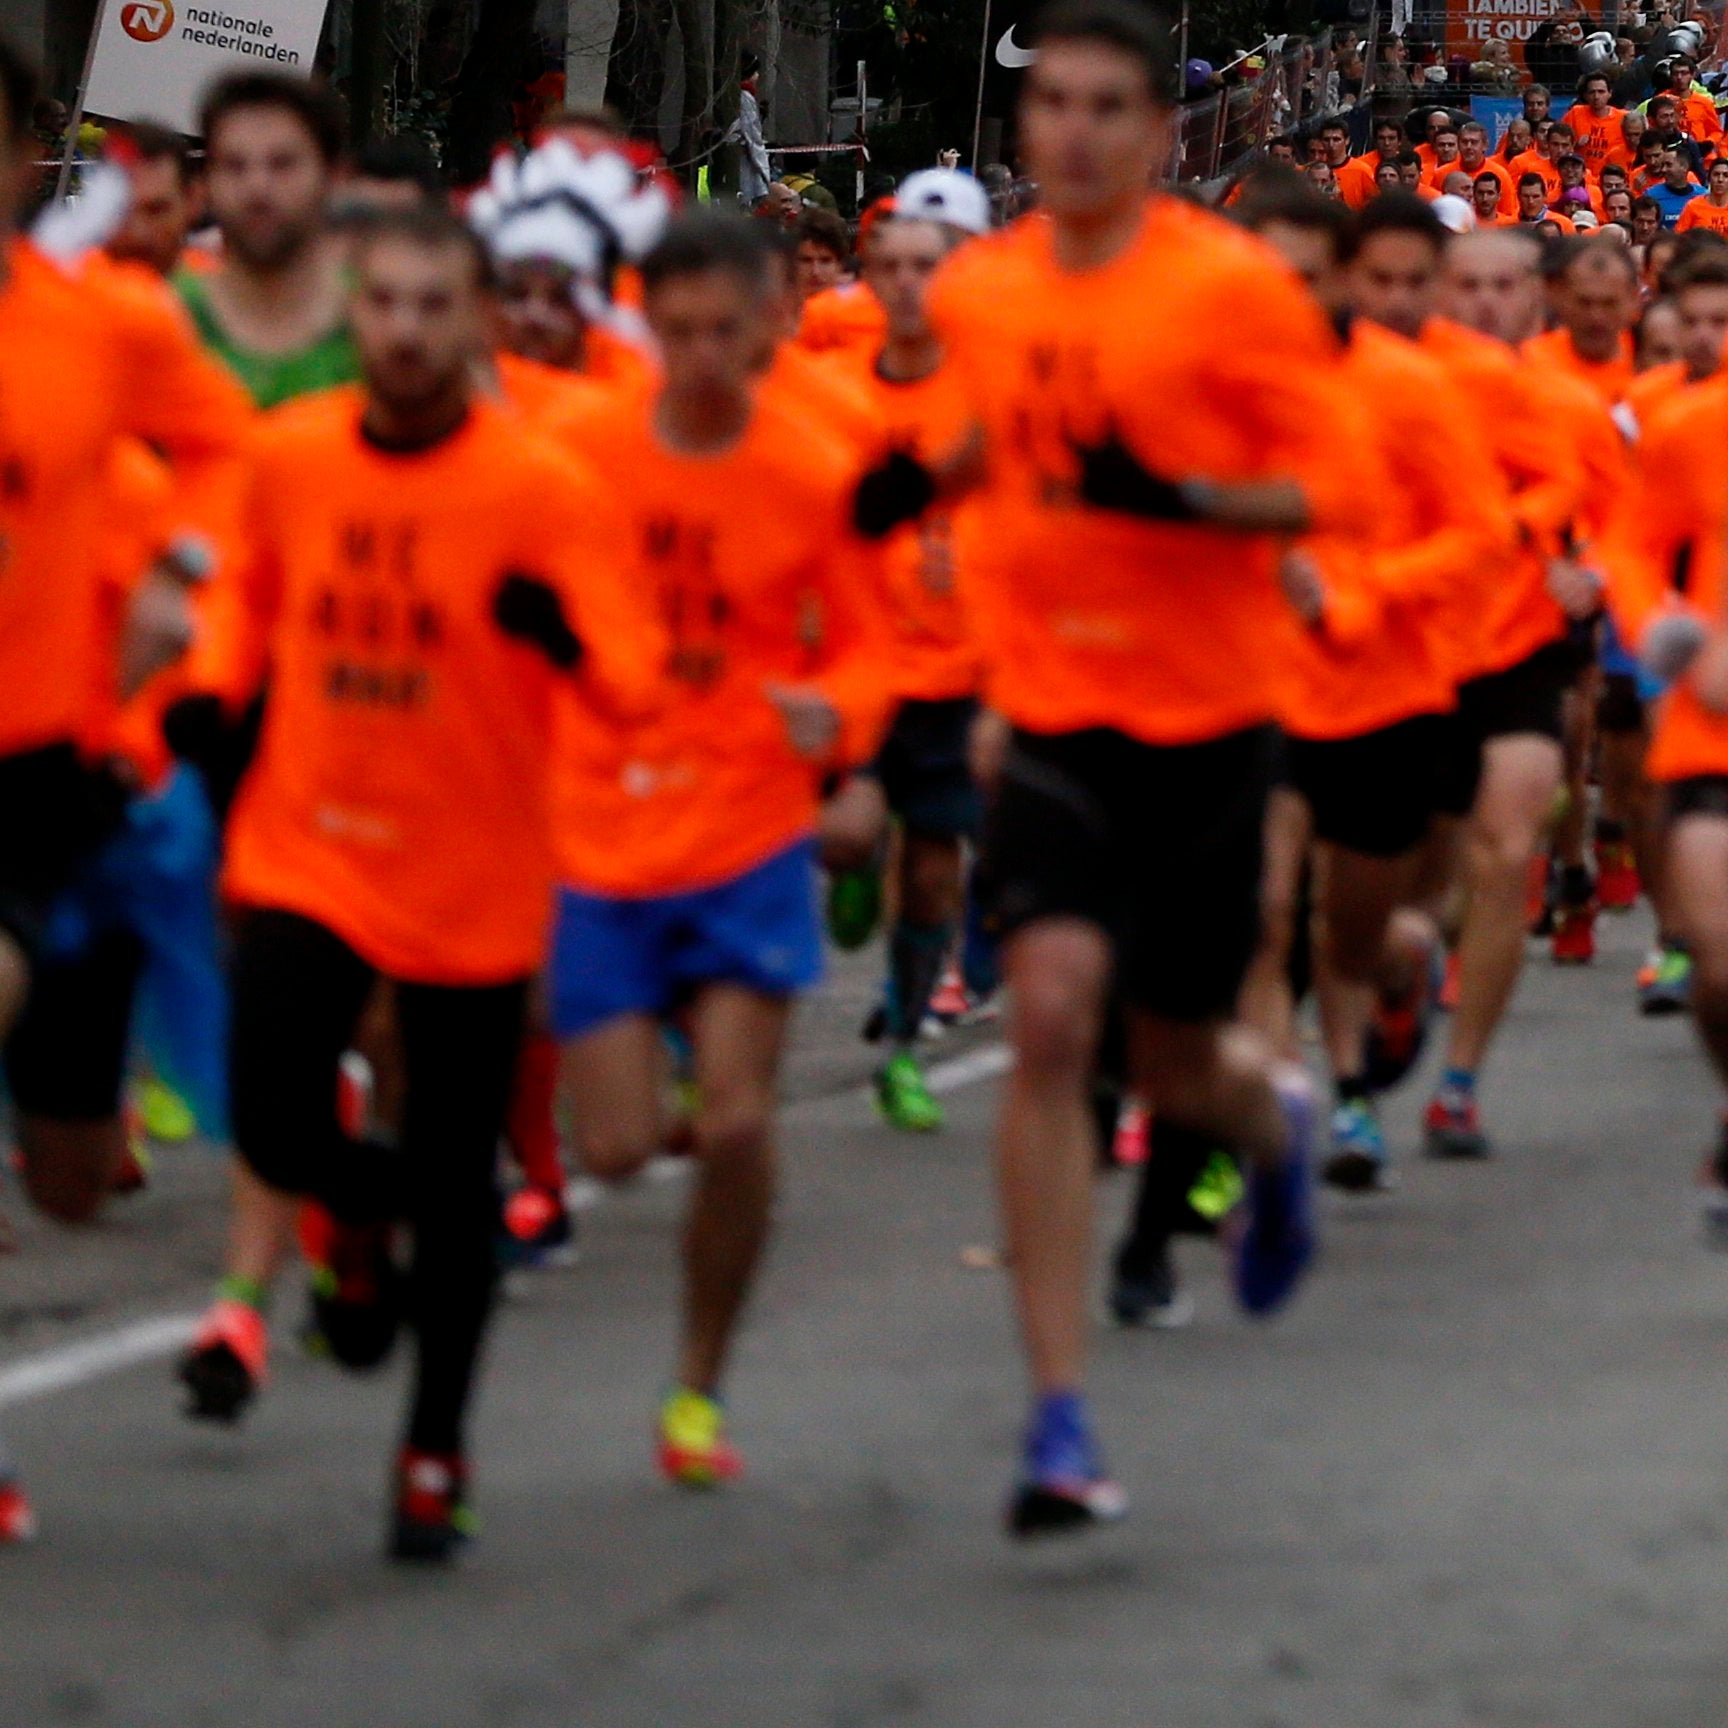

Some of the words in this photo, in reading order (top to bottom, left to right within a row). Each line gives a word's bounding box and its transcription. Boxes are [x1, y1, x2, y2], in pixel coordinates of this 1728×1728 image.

[187, 7, 273, 38] nationale
[1464, 20, 1490, 40] TE
[182, 27, 299, 65] nederlanden
